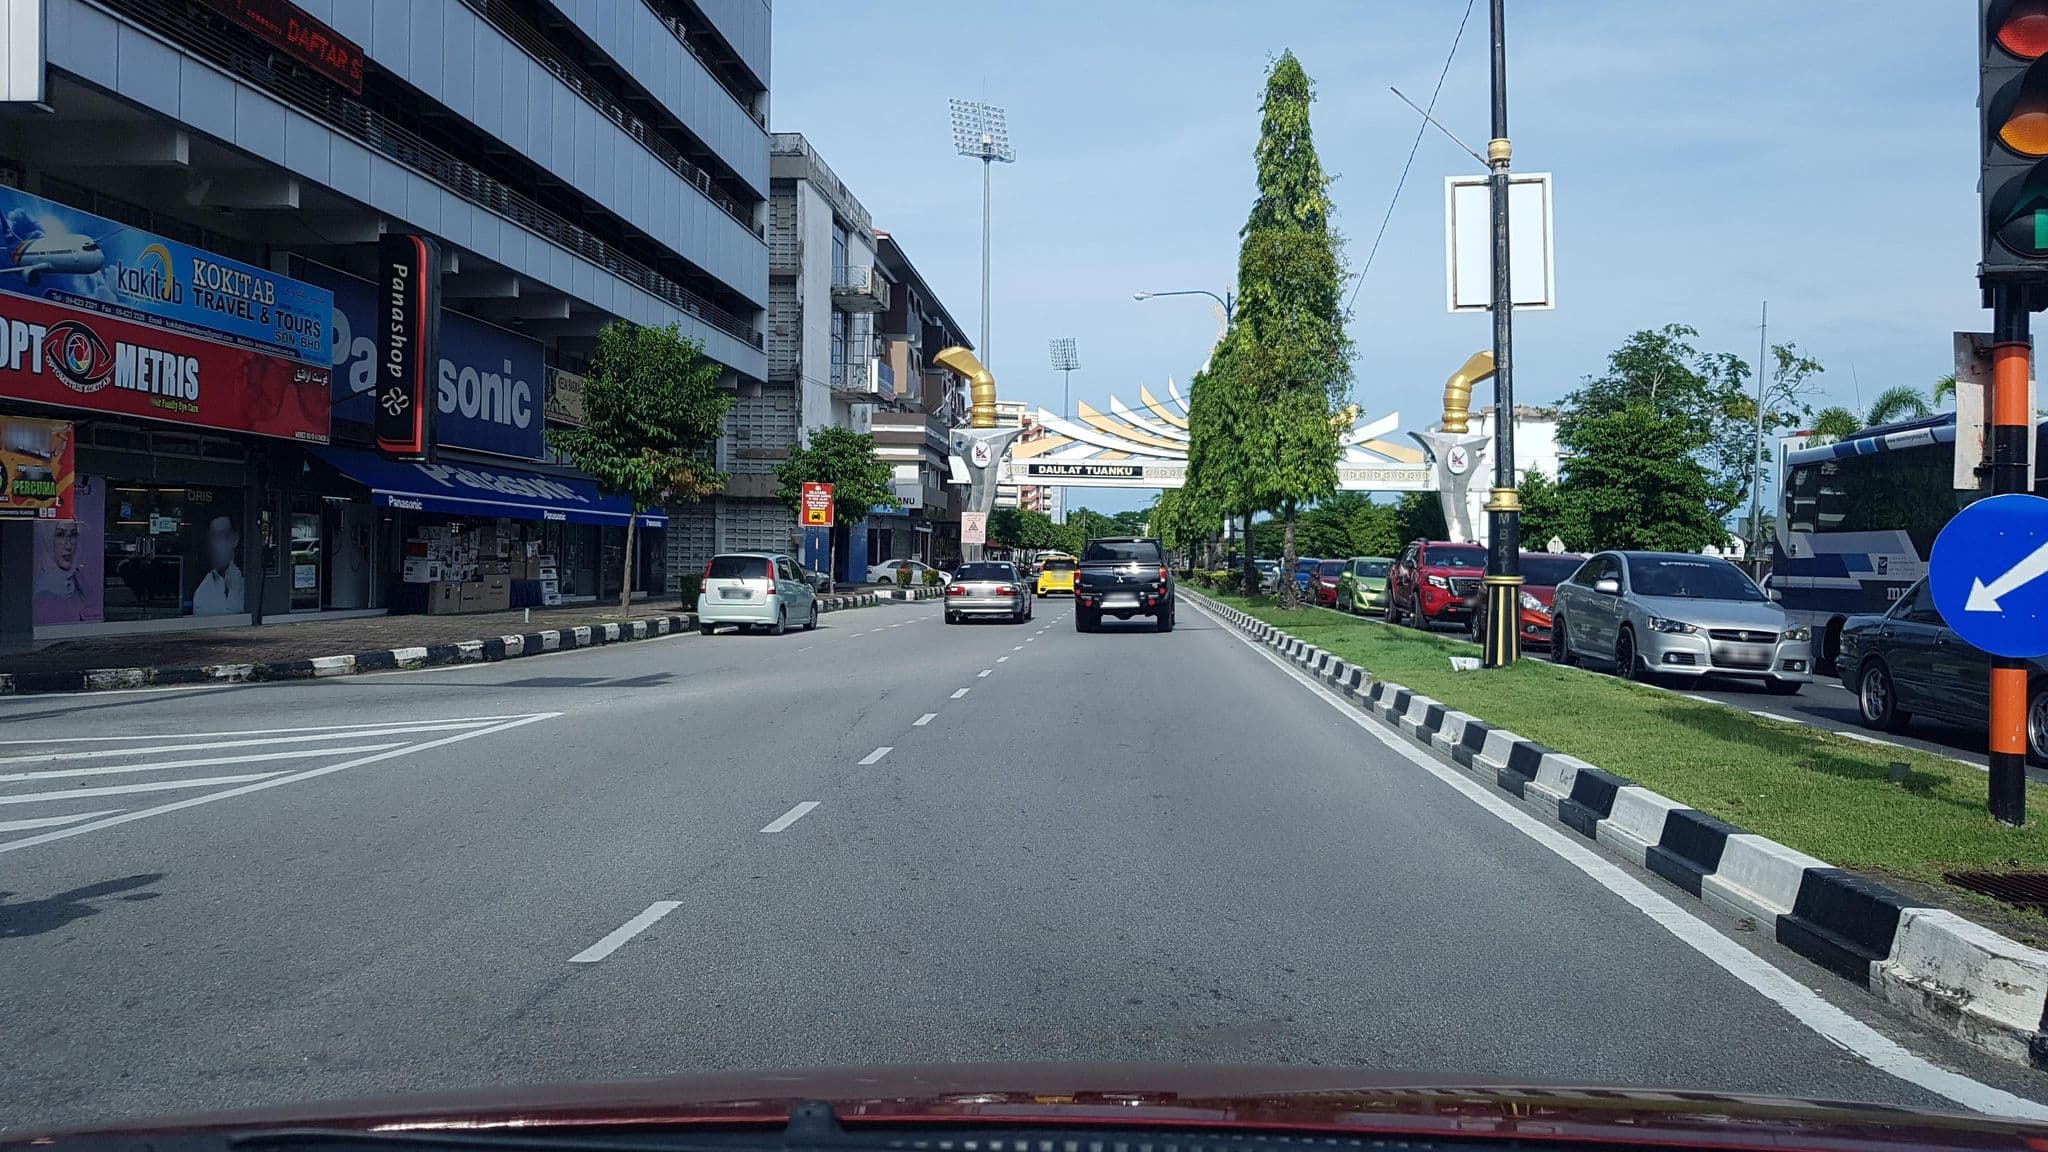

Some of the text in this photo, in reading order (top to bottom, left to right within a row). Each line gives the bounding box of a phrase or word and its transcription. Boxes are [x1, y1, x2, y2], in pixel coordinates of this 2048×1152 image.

[117, 260, 183, 305] kokitab
[193, 258, 275, 306] KOKITAB
[193, 287, 255, 321] TRAVEL
[260, 306, 270, 325] &
[275, 309, 321, 339] TOURS
[386, 263, 408, 378] Panashop
[114, 341, 200, 401] METRIS
[13, 479, 56, 496] PERCUMA
[1038, 465, 1133, 476] DAULAT TUANKU
[388, 495, 423, 511] Panasonic
[543, 510, 567, 522] Panasonic
